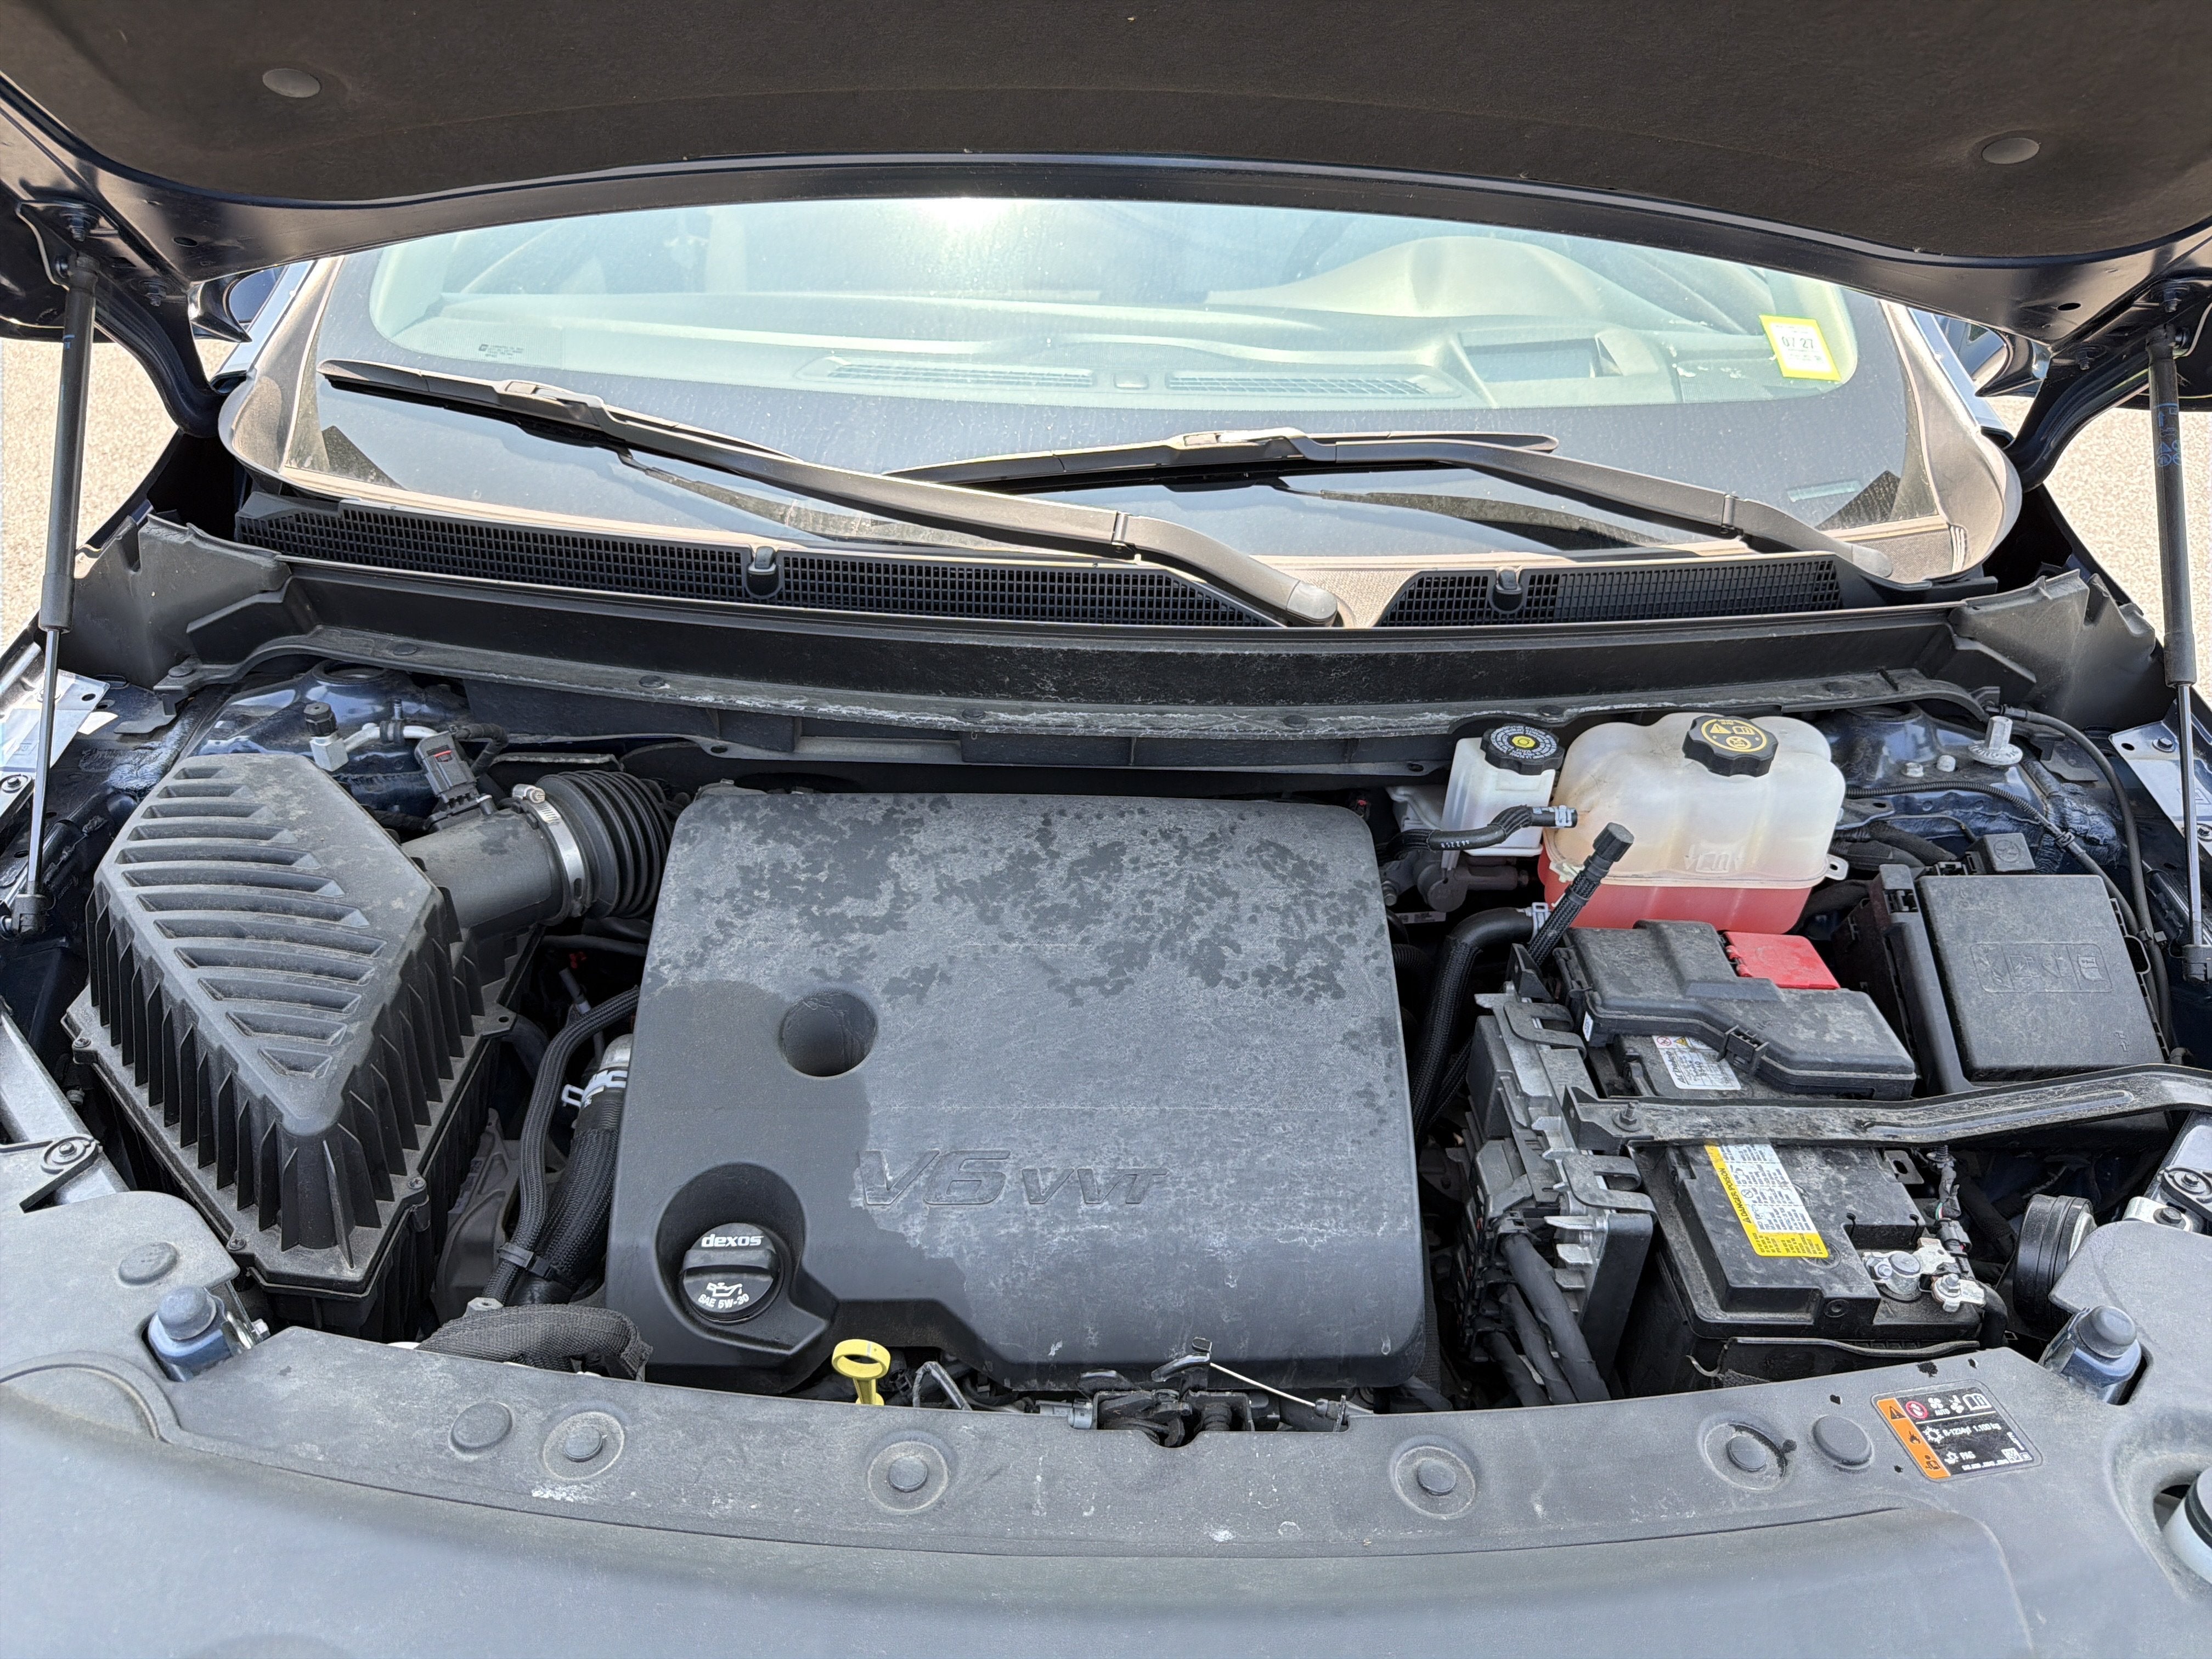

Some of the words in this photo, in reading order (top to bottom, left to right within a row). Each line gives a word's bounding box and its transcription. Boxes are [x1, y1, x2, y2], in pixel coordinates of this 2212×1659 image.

[1781, 336, 1796, 348] 07
[1800, 337, 1814, 349] 27
[859, 1148, 1012, 1206] V6
[1020, 1167, 1170, 1205] VVT
[701, 1233, 764, 1248] dexos
[698, 1294, 716, 1308] SAE
[718, 1293, 750, 1309] 5W-30
[1934, 1408, 1950, 1417] AUTO
[1991, 1422, 2002, 1431] kg
[1959, 1451, 1976, 1460] PAG
